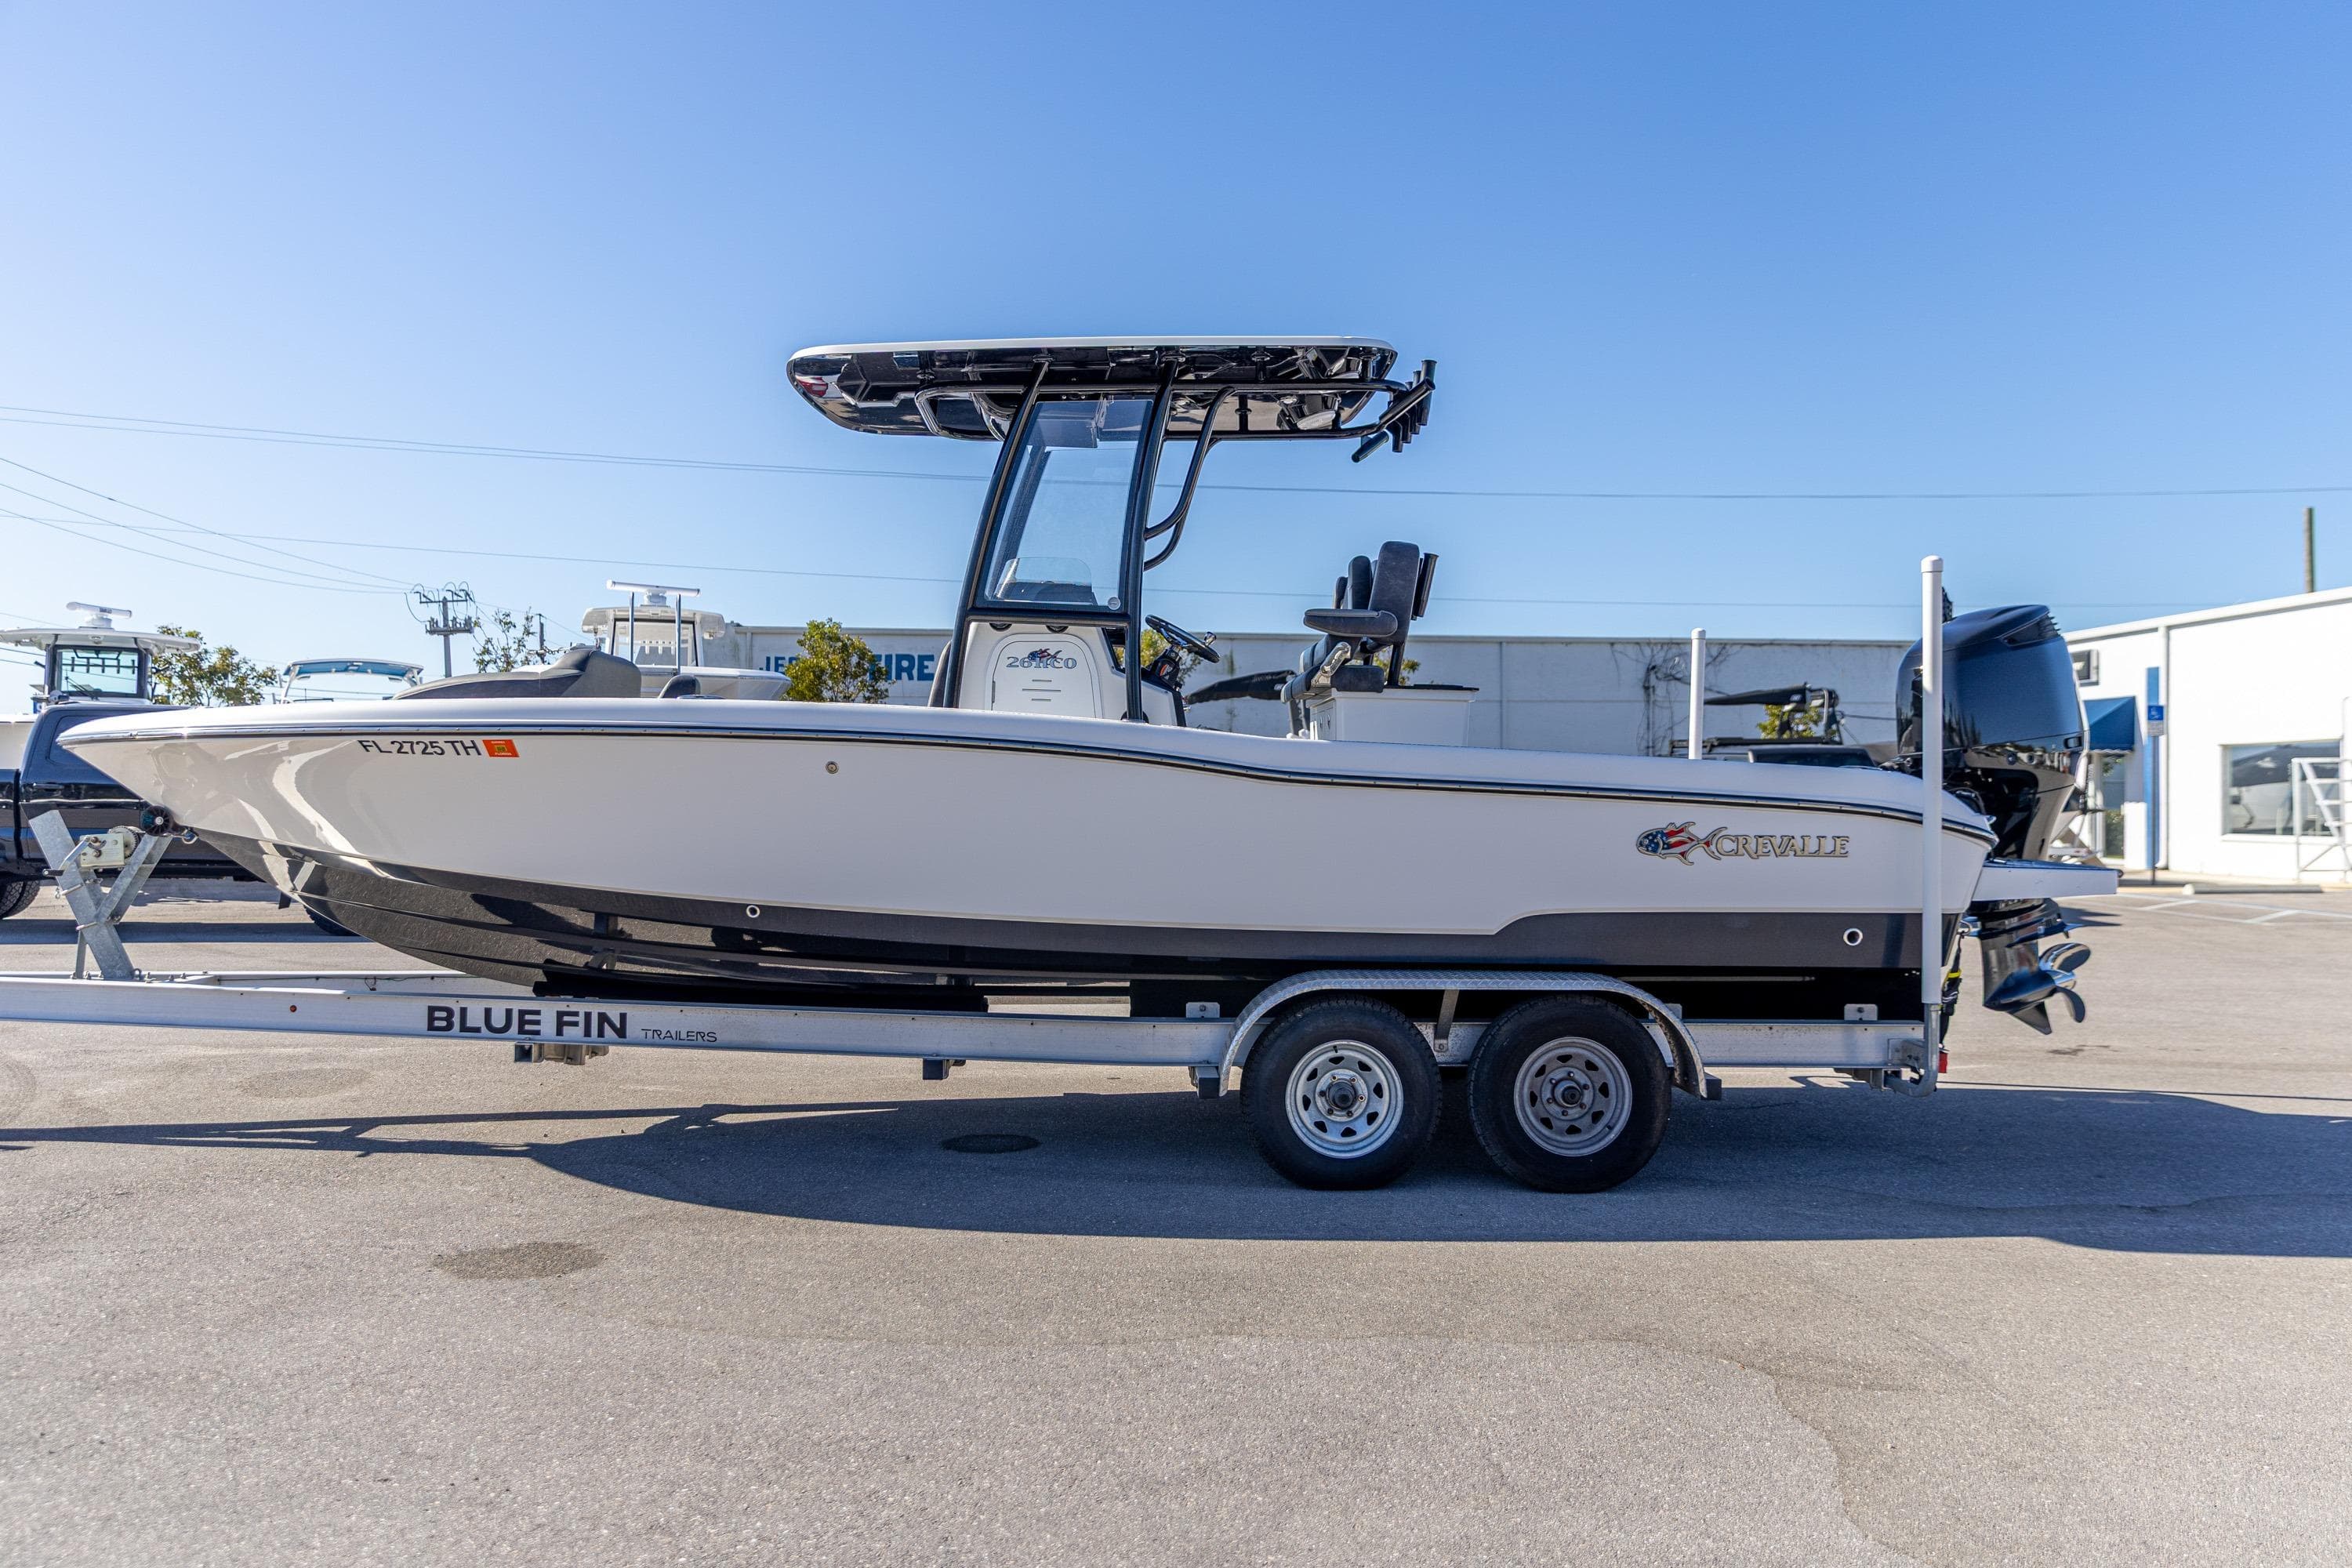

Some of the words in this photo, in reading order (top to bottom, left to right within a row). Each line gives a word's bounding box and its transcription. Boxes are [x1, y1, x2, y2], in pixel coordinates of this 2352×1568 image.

[358, 740, 392, 753] FL
[391, 740, 445, 756] 2725
[445, 740, 482, 756] TH
[1715, 835, 1850, 859] CREVALLE
[426, 1005, 542, 1035] BLUE
[555, 1011, 627, 1039] FIN
[641, 1029, 717, 1043] TRAILERS
